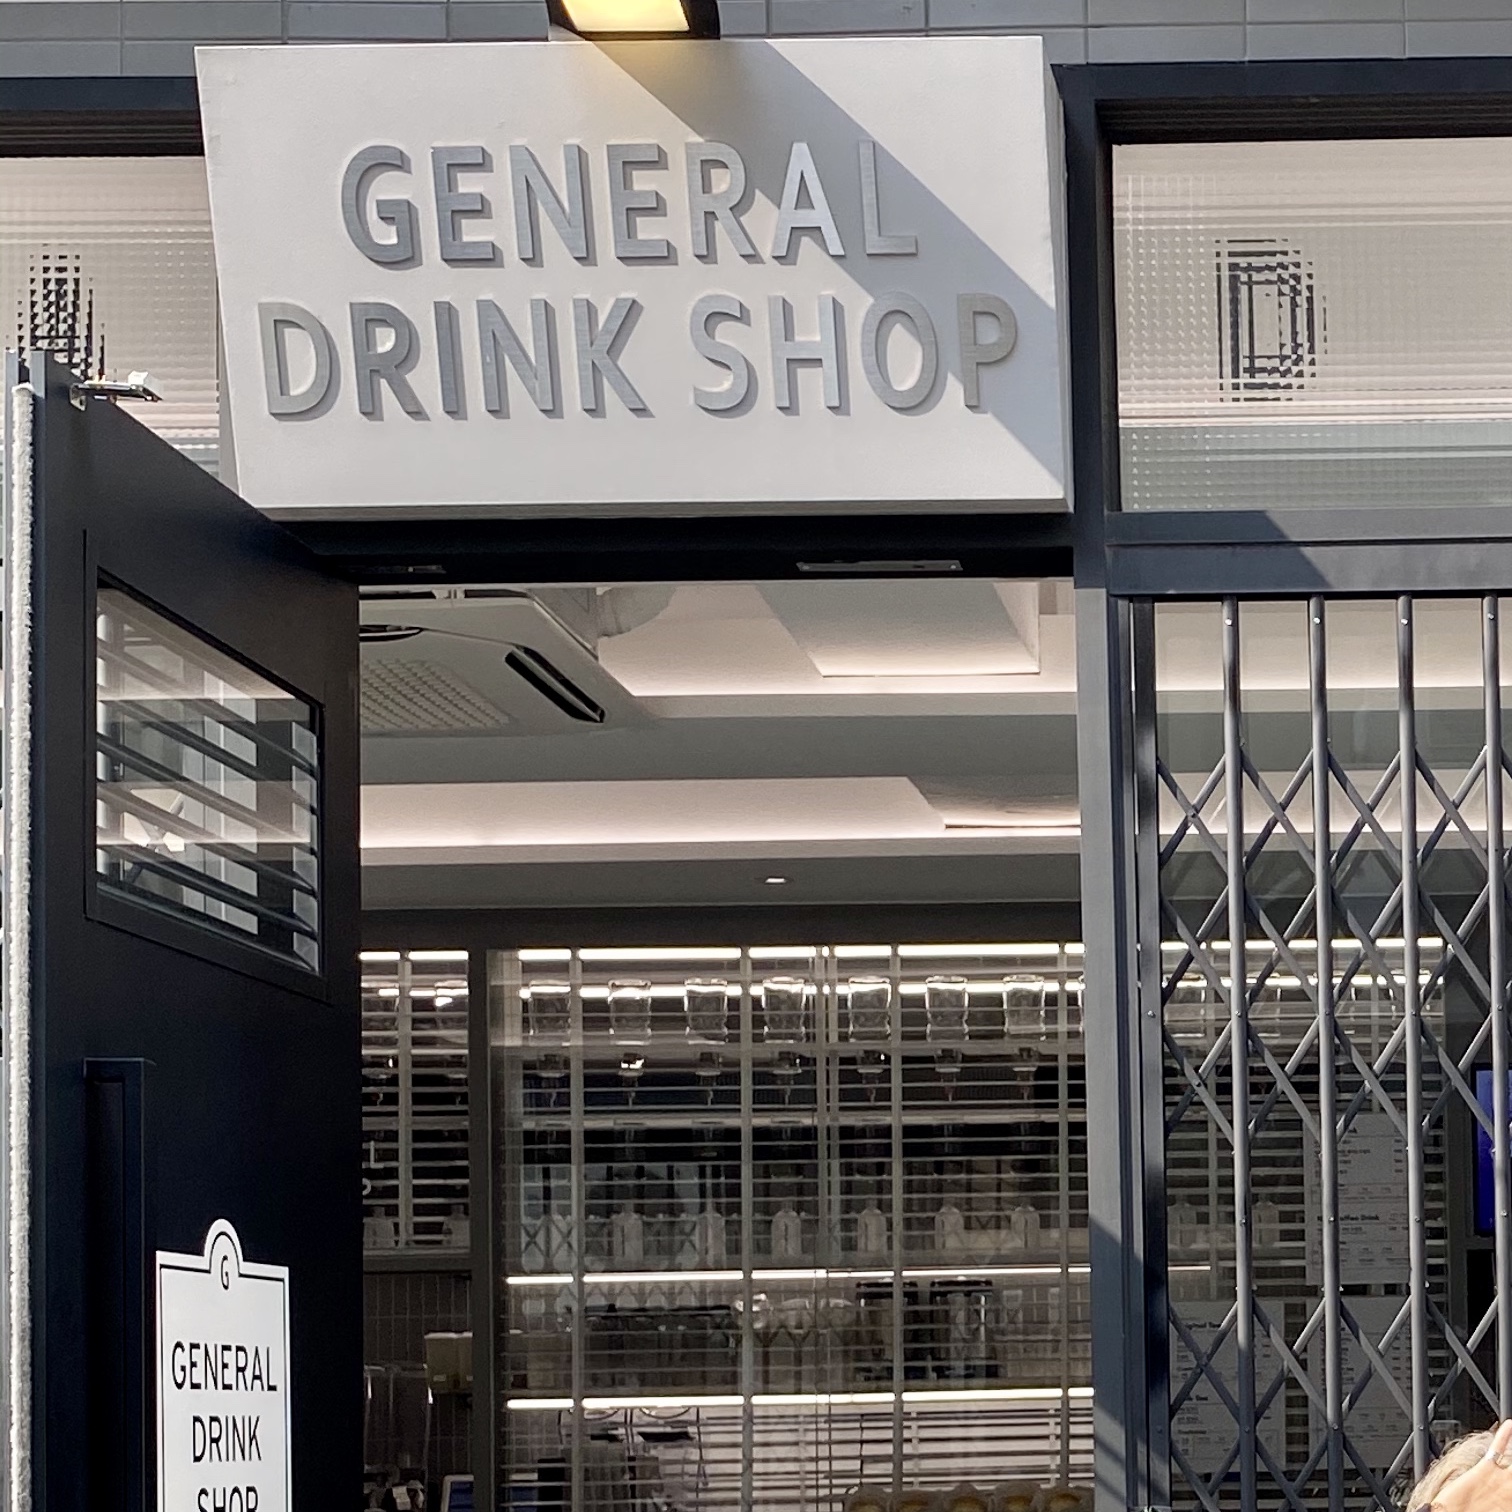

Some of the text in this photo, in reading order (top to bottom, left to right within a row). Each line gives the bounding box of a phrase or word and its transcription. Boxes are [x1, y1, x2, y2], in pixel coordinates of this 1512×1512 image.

[341, 140, 918, 267] GENERAL
[257, 291, 1019, 419] DRINK SHOP
[219, 1254, 230, 1291] G
[171, 1341, 278, 1392] GENERAL
[192, 1415, 262, 1463] DRINK
